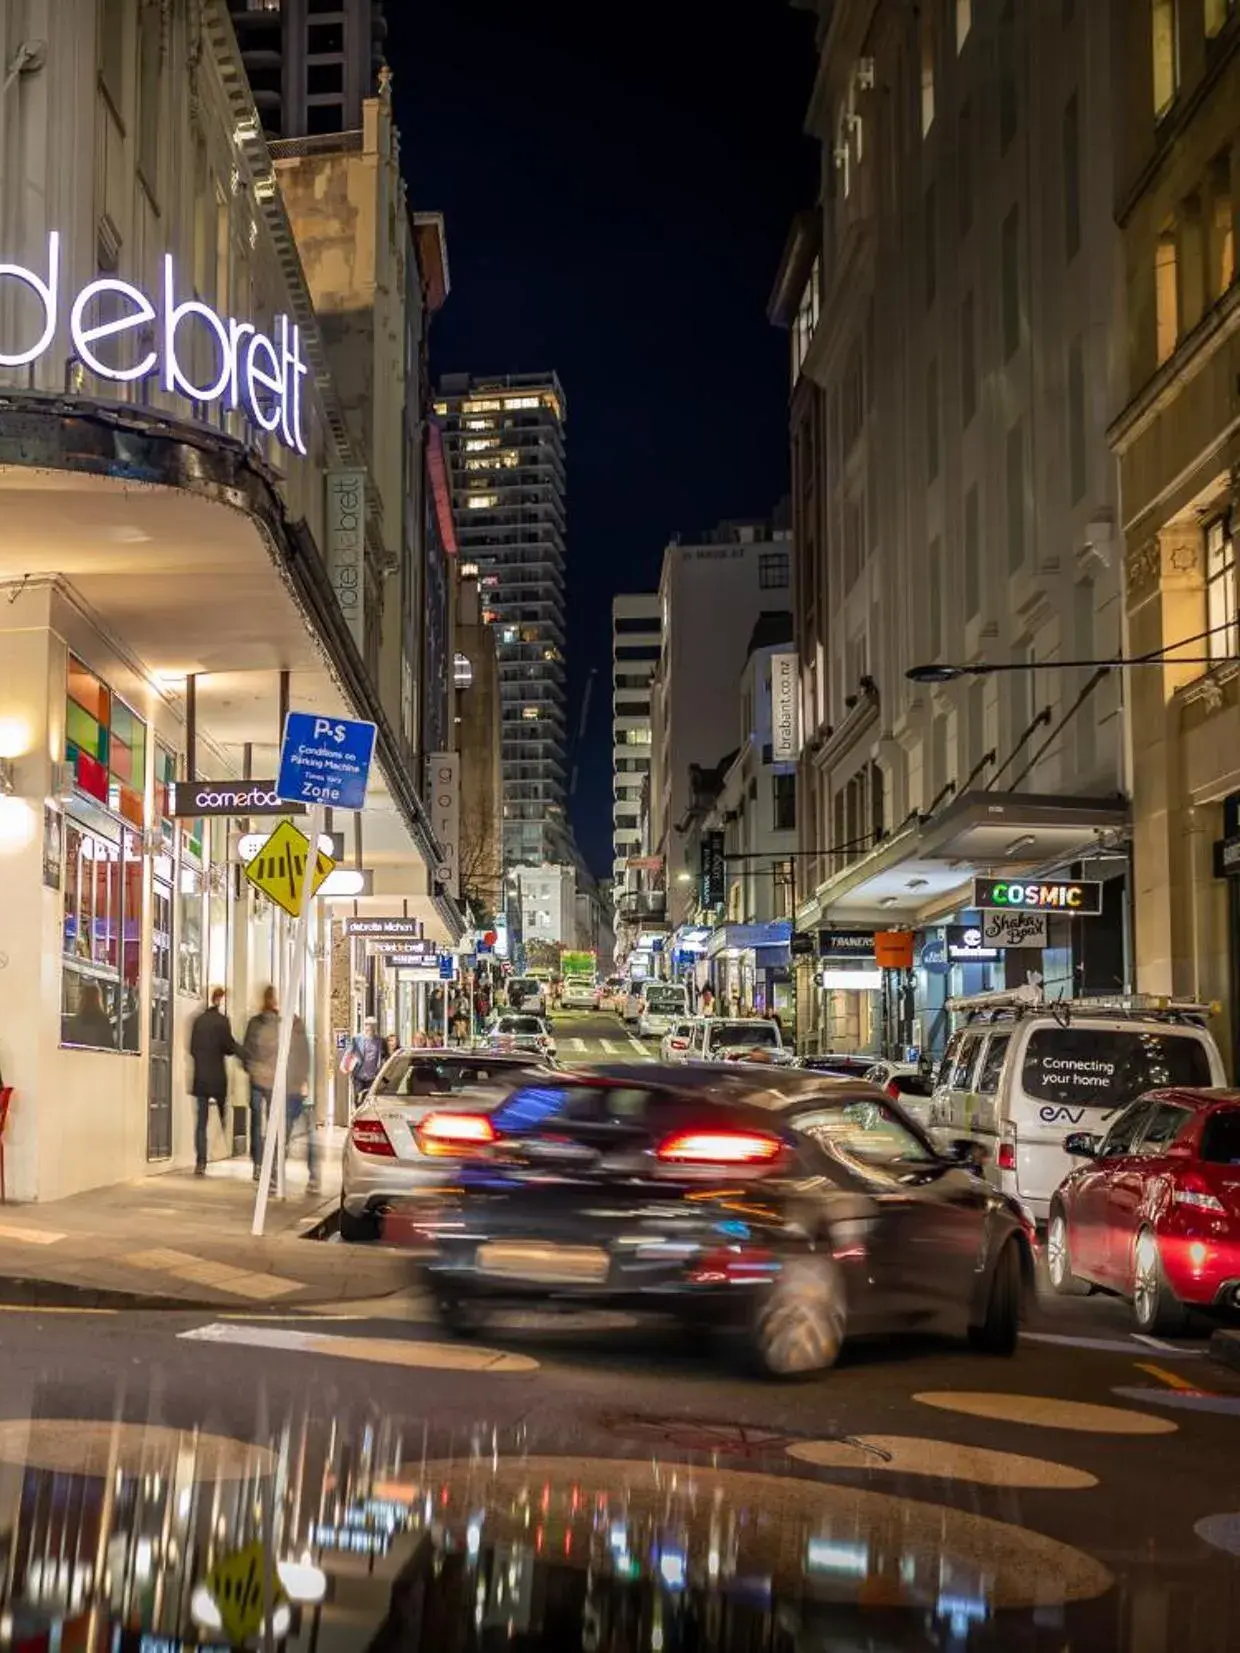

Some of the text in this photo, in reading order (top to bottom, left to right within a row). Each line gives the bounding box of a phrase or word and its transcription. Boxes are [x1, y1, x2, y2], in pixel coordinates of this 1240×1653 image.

[298, 744, 357, 762] Conditions on
[290, 754, 360, 773] Parking Machine
[196, 787, 281, 808] cornerba
[301, 781, 340, 800] Zone
[991, 883, 1082, 907] COSMIC
[1042, 1057, 1115, 1075] Connecting
[1041, 1073, 1111, 1087] your home
